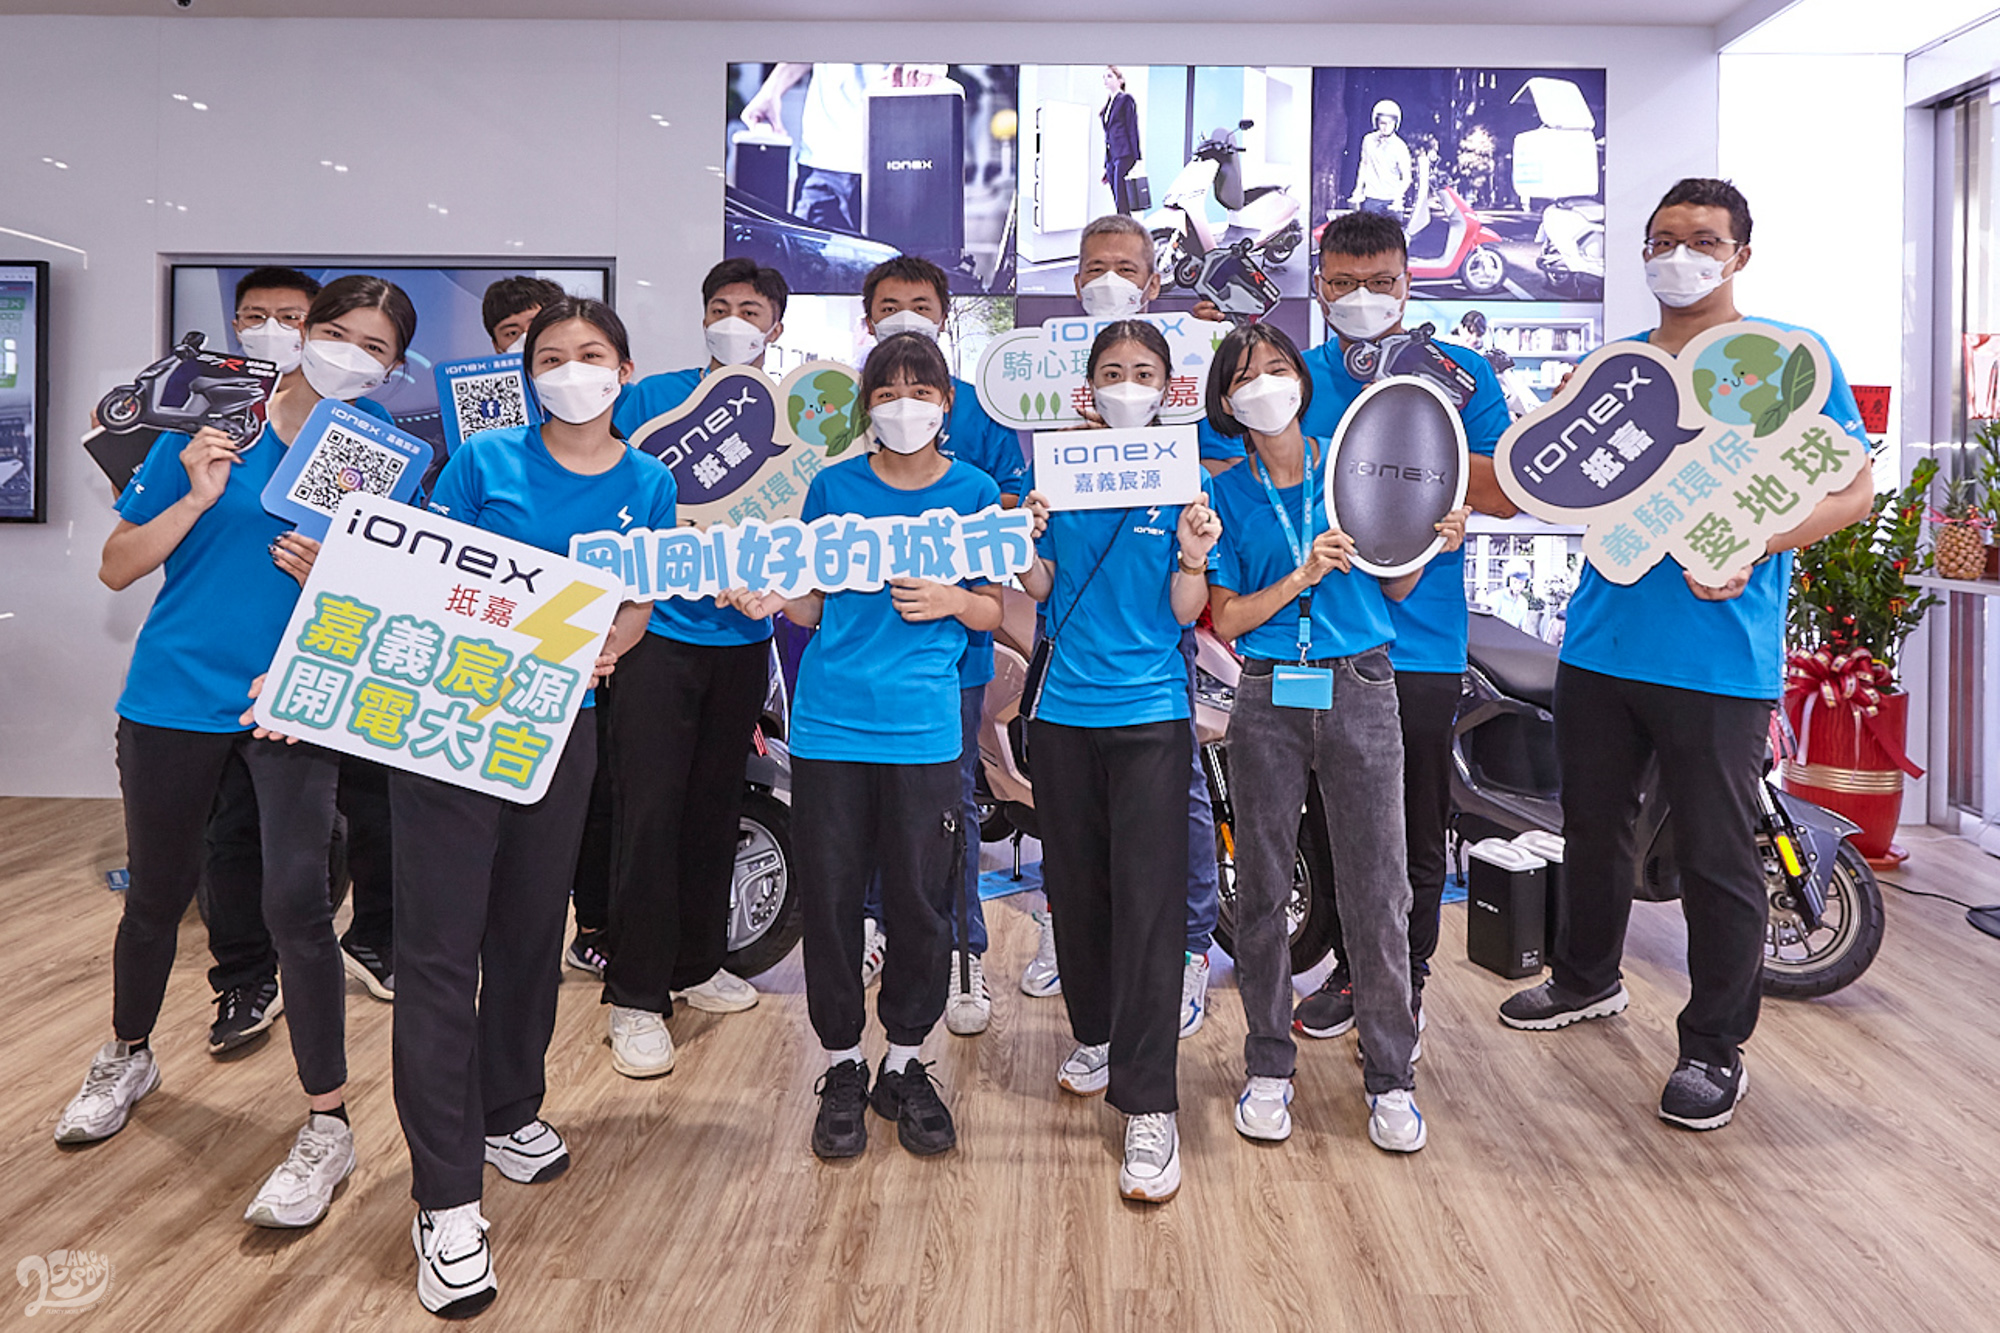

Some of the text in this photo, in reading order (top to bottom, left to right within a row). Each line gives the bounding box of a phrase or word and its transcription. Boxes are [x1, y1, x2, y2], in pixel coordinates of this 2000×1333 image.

[330, 406, 382, 437] ionex
[656, 386, 758, 470] onex
[692, 431, 754, 490] 抵嘉
[1054, 441, 1178, 465] ionex
[1523, 365, 1653, 484] ionex
[1579, 419, 1655, 490] 抵嘉
[711, 447, 826, 526] 騎環保
[1073, 470, 1162, 494] 嘉義宸源
[1599, 428, 1760, 568] 義騎環保
[1683, 426, 1851, 571] 愛地球
[346, 508, 545, 594] ionex
[576, 511, 1029, 595] 剛剛好的城市
[444, 583, 518, 628] 抵嘉
[300, 592, 579, 722] 嘉義宸源
[272, 656, 553, 789] 開電大吉
